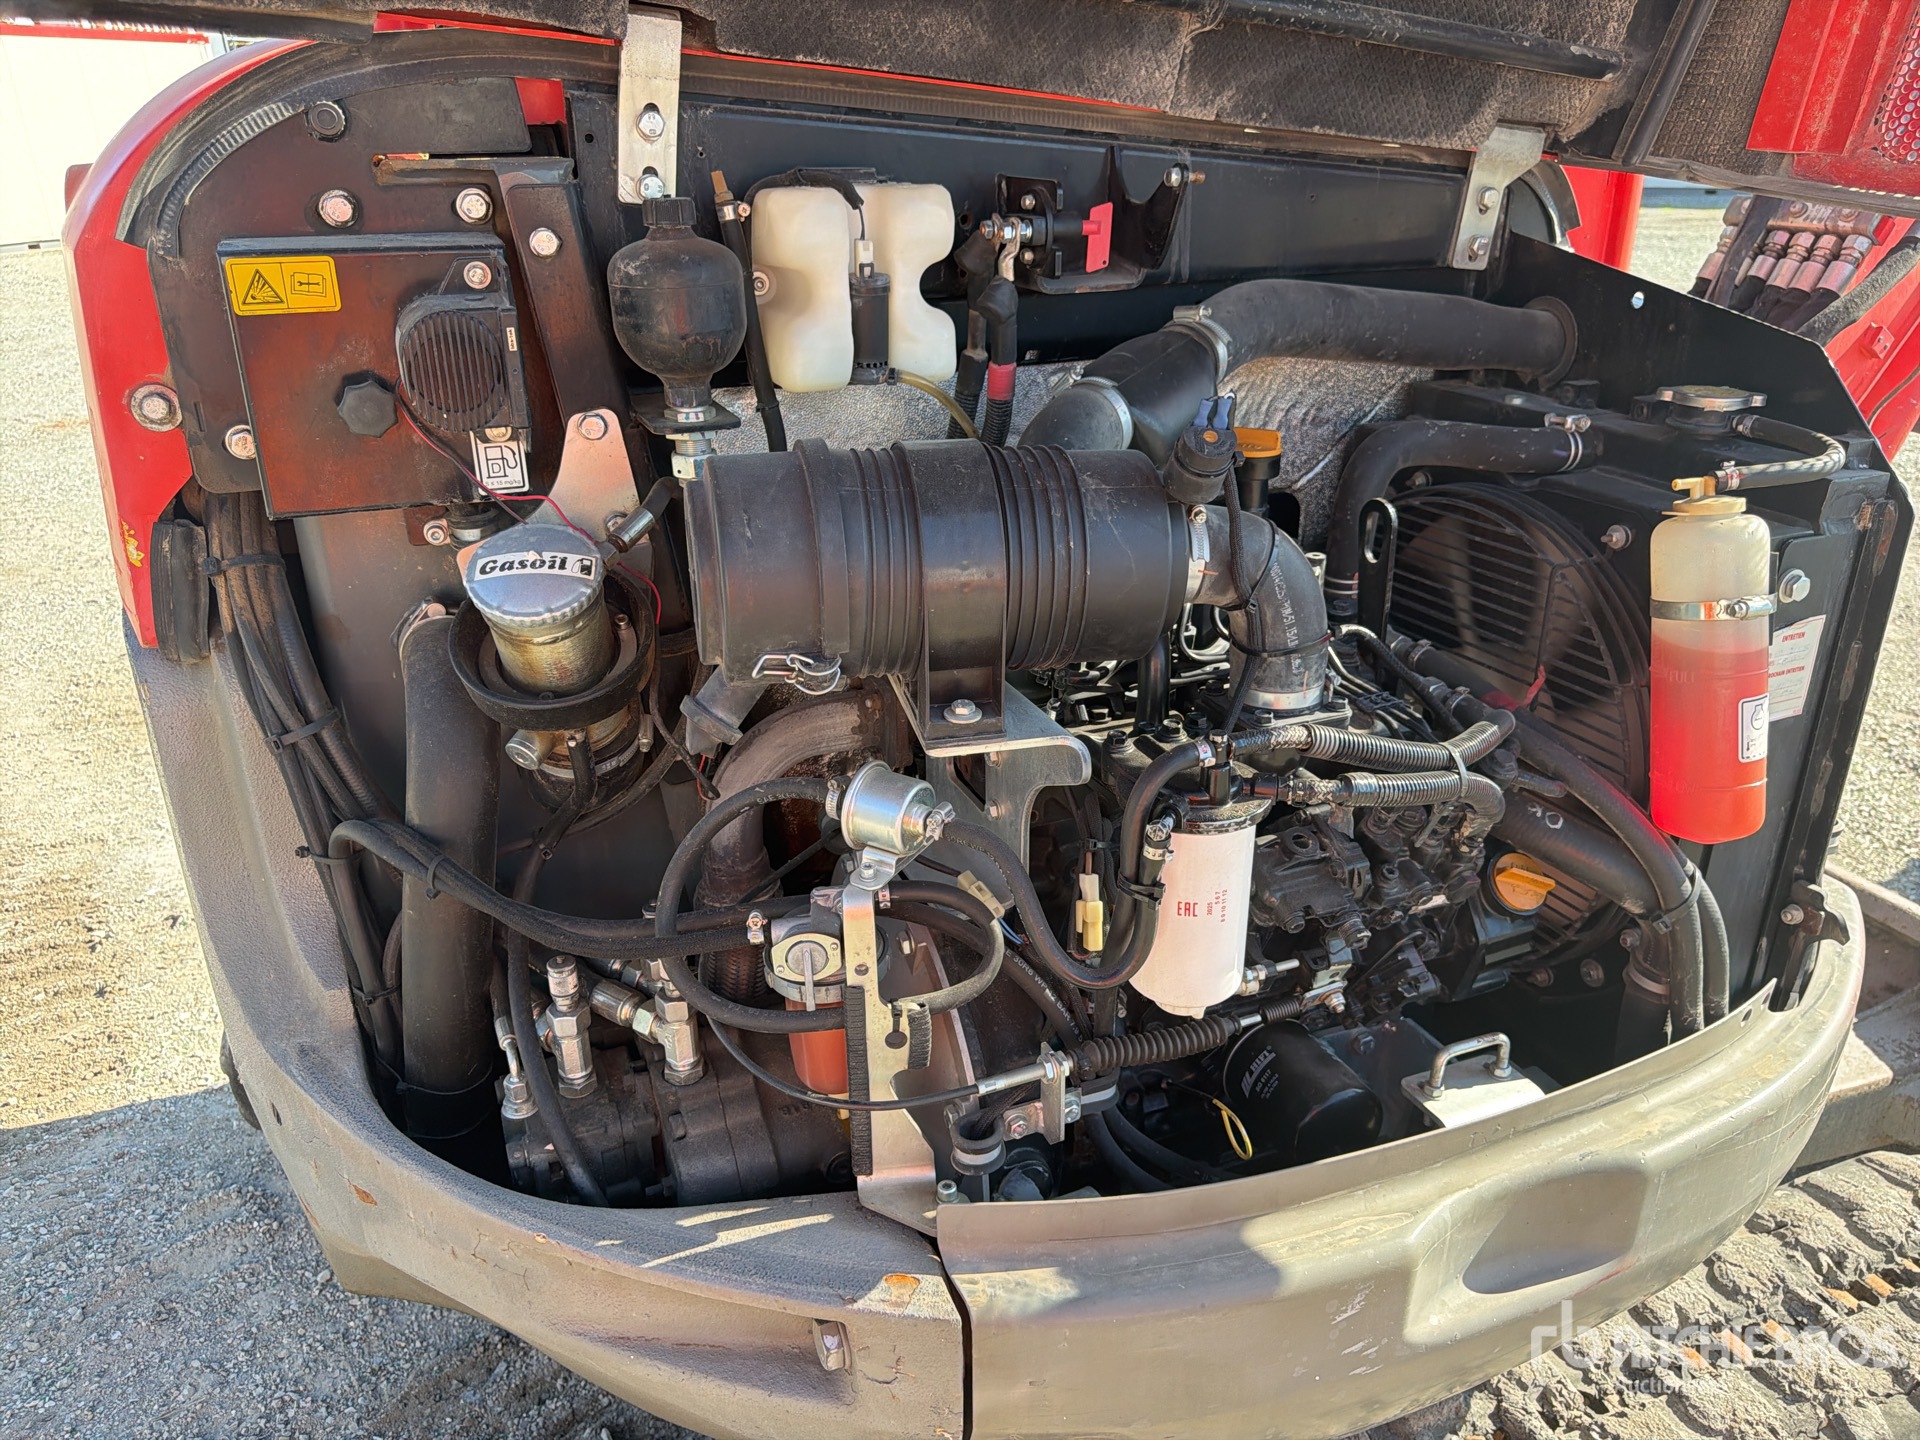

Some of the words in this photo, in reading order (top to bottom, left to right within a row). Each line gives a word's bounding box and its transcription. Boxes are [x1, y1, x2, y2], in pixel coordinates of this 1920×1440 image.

[491, 462, 502, 474] D
[479, 555, 568, 576] Gasoil
[1781, 631, 1806, 643] ENTRETIEN
[1768, 670, 1785, 679] ROCHAIN
[1177, 901, 1199, 917] EAC
